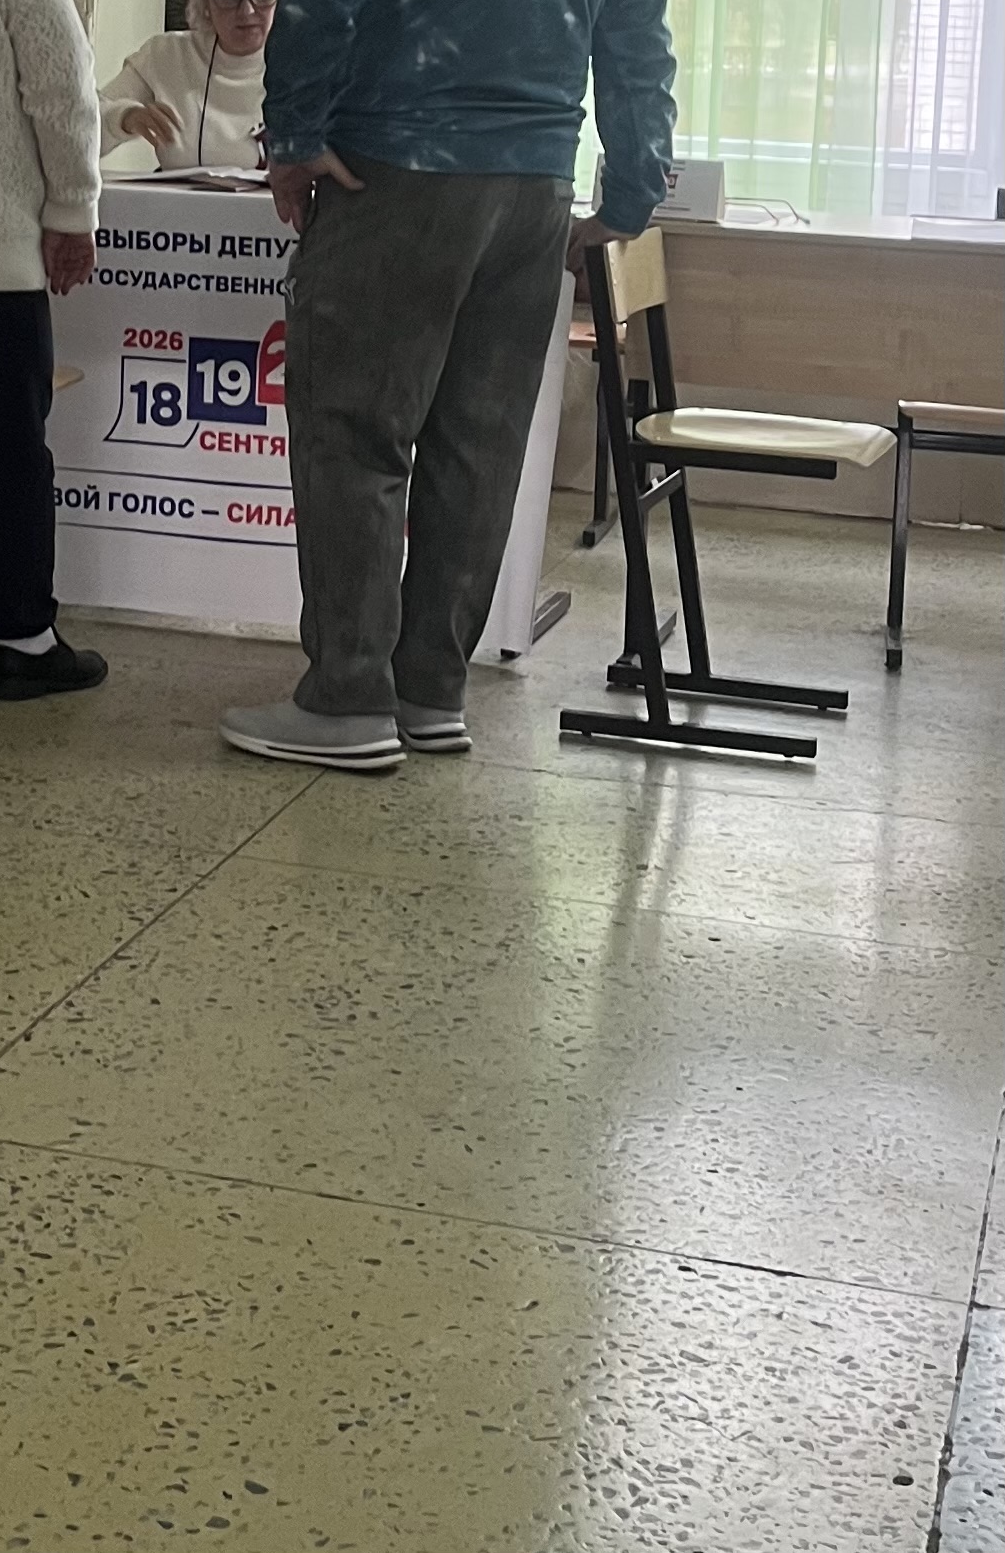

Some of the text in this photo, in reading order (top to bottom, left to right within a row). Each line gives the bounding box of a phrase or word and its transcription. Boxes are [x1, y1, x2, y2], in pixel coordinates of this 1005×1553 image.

[96, 228, 298, 259] ВЫБОРЫ ДЕПУ
[123, 328, 184, 351] 2026
[130, 340, 286, 427] 18 19 2
[199, 430, 286, 457] СЕНТЯ
[54, 484, 101, 511] ВОЙ
[108, 492, 195, 519] ГОЛОС
